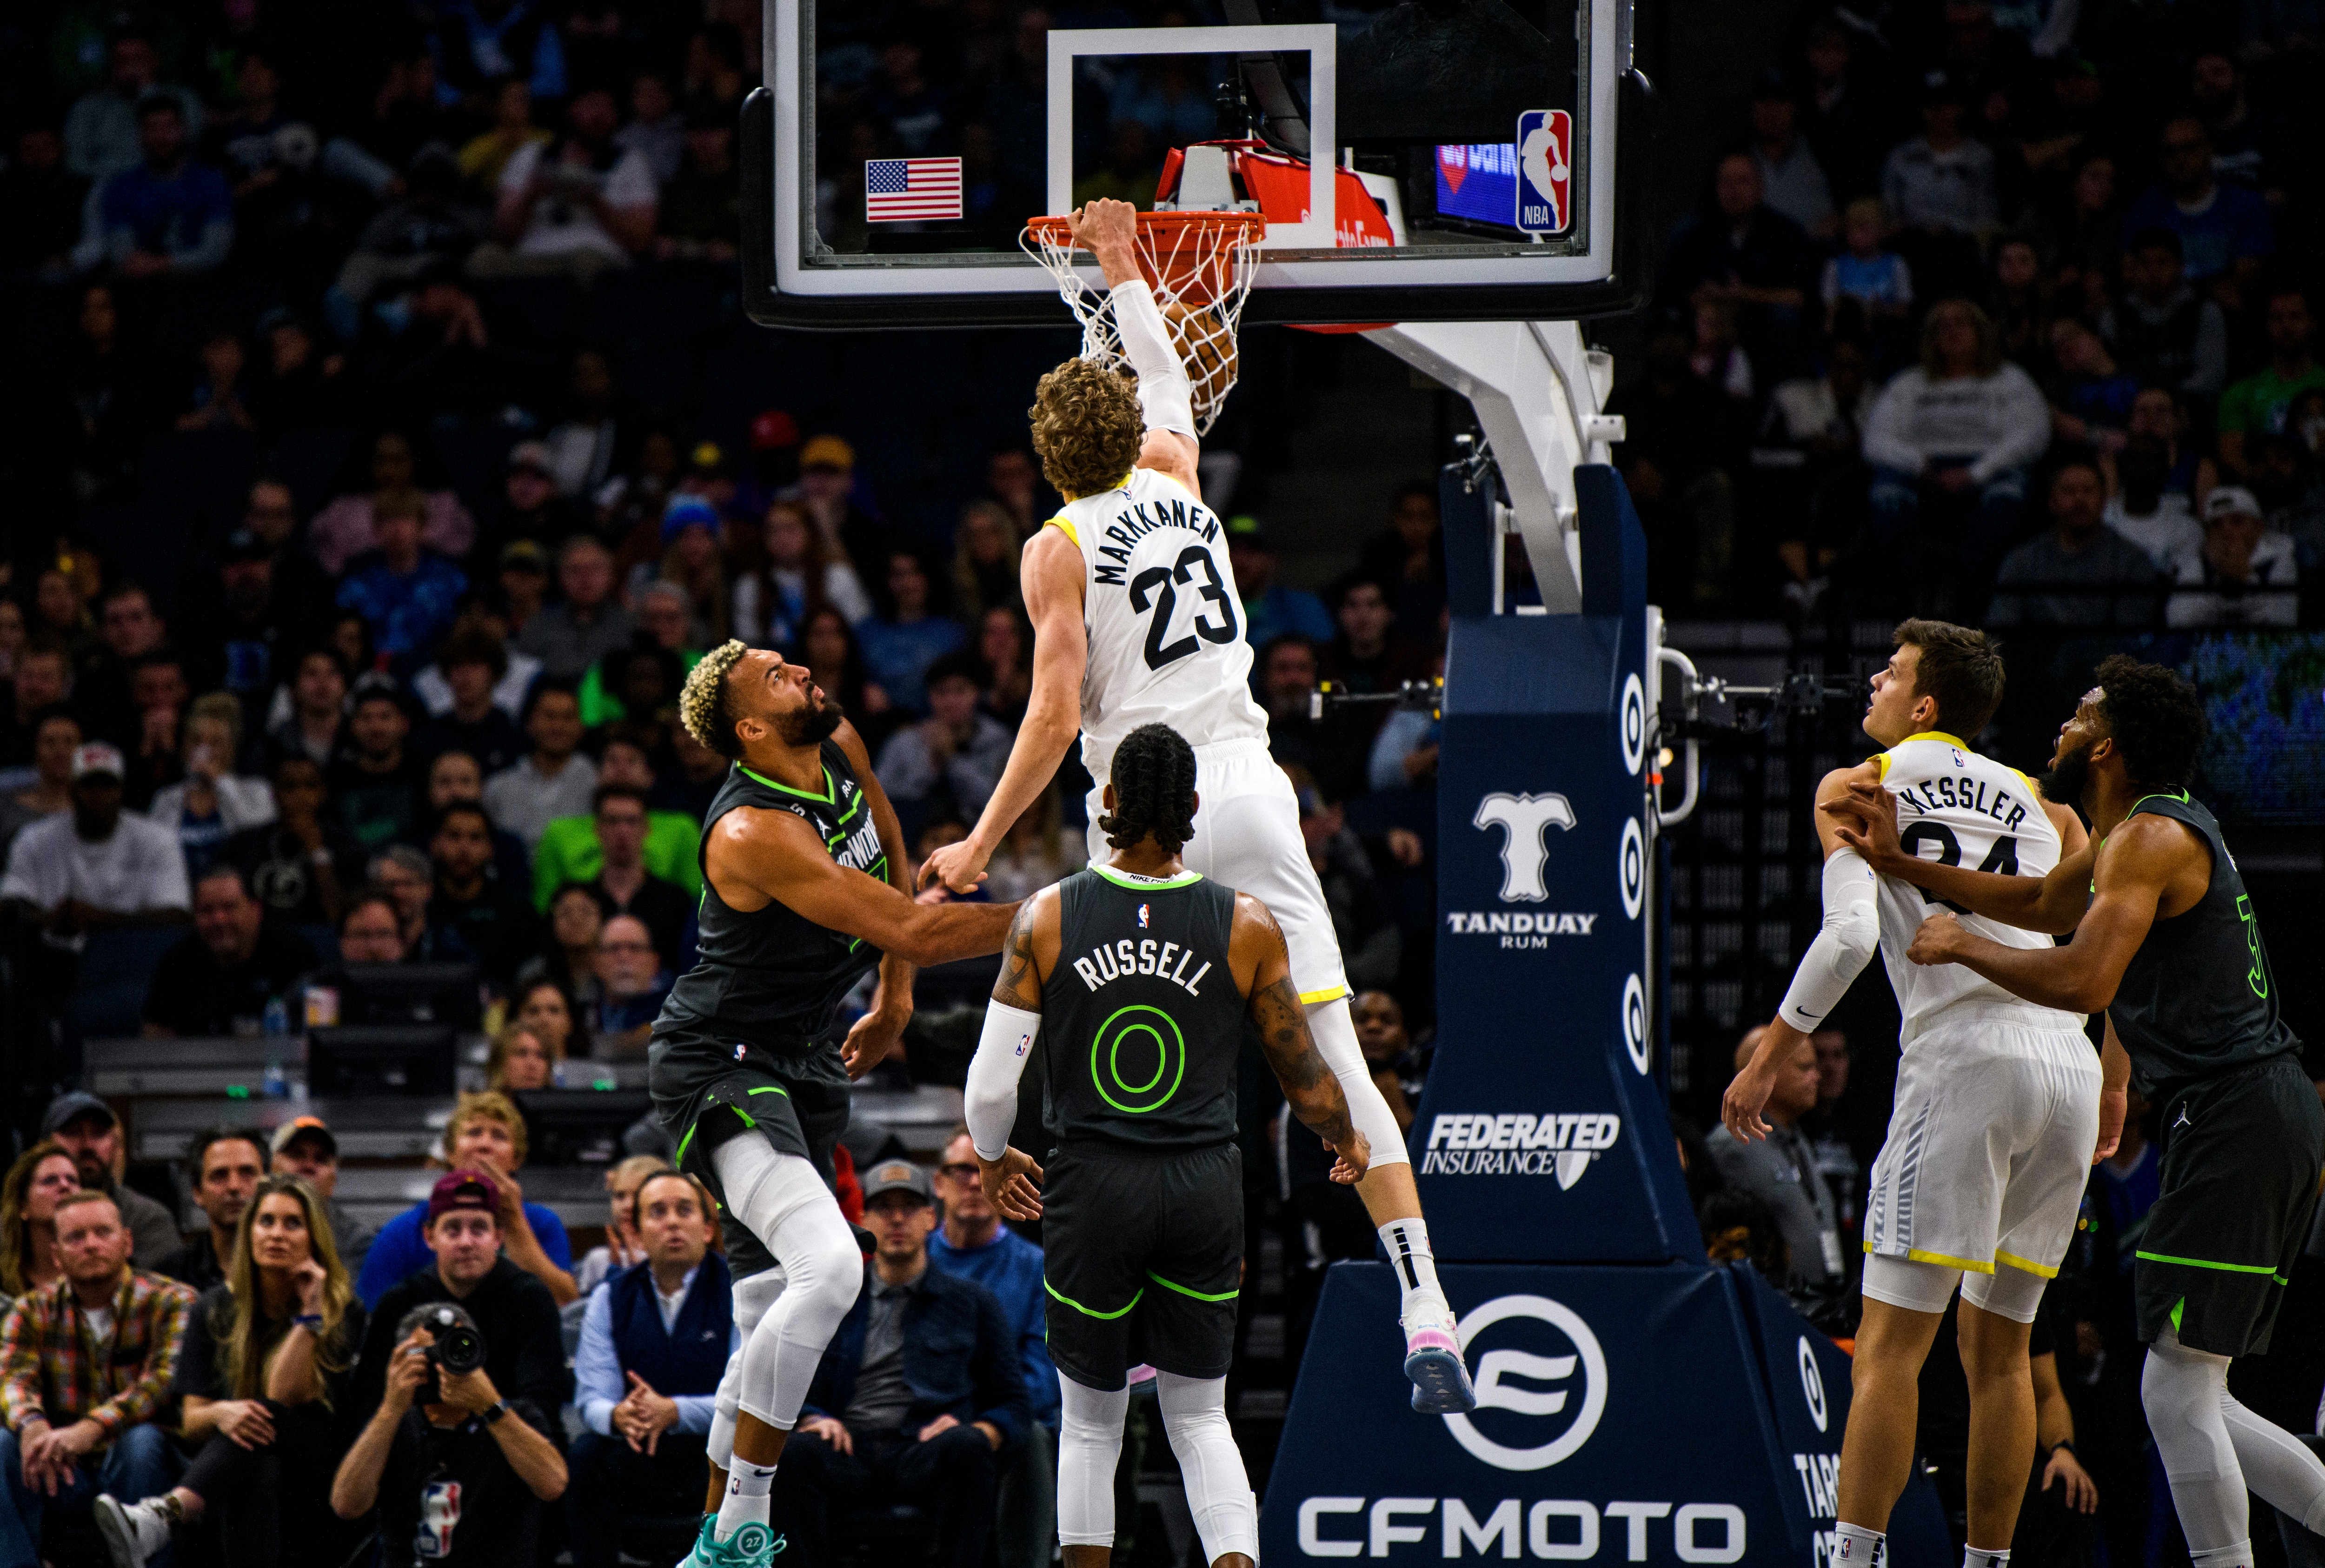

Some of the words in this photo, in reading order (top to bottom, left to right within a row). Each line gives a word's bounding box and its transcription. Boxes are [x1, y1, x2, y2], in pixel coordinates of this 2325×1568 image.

[1524, 206, 1549, 225] NBA
[1095, 499, 1219, 586] MARKKANEN
[1129, 545, 1238, 672] 23
[1899, 776, 2026, 833] KESSLER
[1129, 874, 1151, 883] NIKE
[1447, 912, 1598, 935] TANDUAY
[1501, 935, 1548, 949] RUM
[1073, 939, 1212, 997] RUSSELL
[1427, 1114, 1621, 1150] FEDERATED
[1421, 1150, 1556, 1175] INSURANCE
[1793, 1453, 1840, 1519] TAR
[1298, 1496, 1747, 1565] CFMOTO
